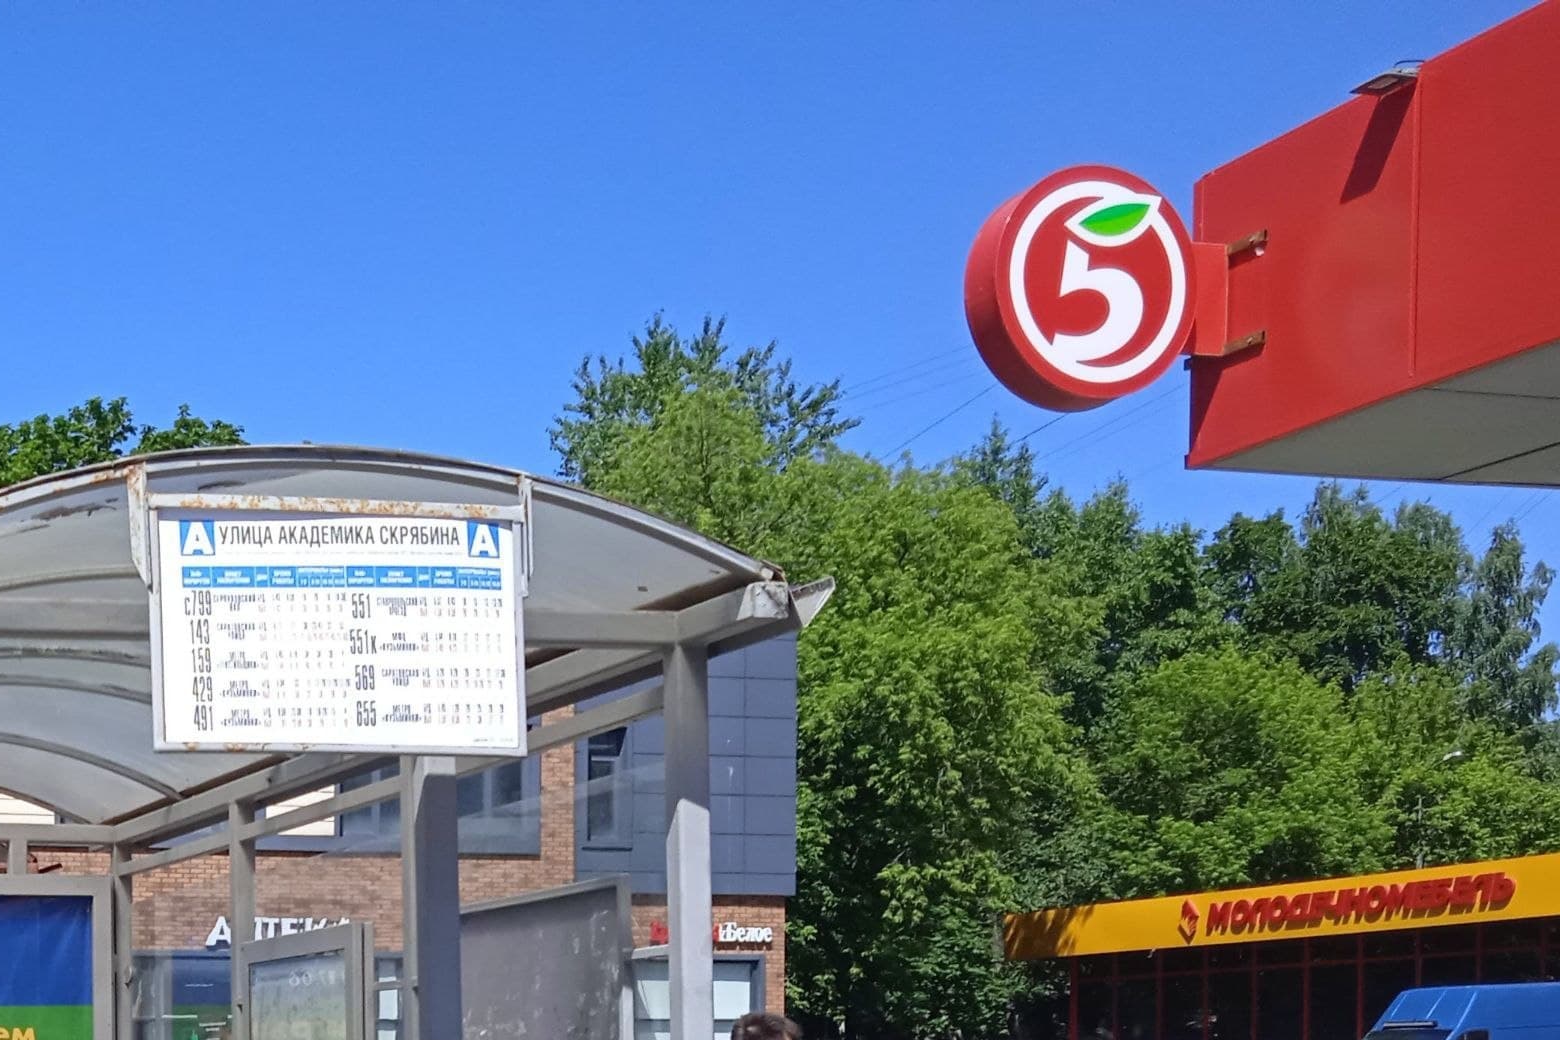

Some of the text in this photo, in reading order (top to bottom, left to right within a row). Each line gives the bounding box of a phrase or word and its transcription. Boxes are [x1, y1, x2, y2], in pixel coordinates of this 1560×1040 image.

[218, 525, 273, 548] УЛИЦА
[278, 525, 375, 548] АКАДЕМИКА
[379, 525, 460, 546] СКРЯБИНА
[351, 593, 371, 619] 551
[190, 619, 210, 644] 143
[192, 647, 212, 673] 159
[192, 676, 213, 702] 429
[355, 665, 375, 690] 569
[193, 704, 213, 731] 491
[356, 700, 376, 727] 655
[1206, 872, 1516, 934] МОЛОДЕЧНОМЕБЕЛЬ
